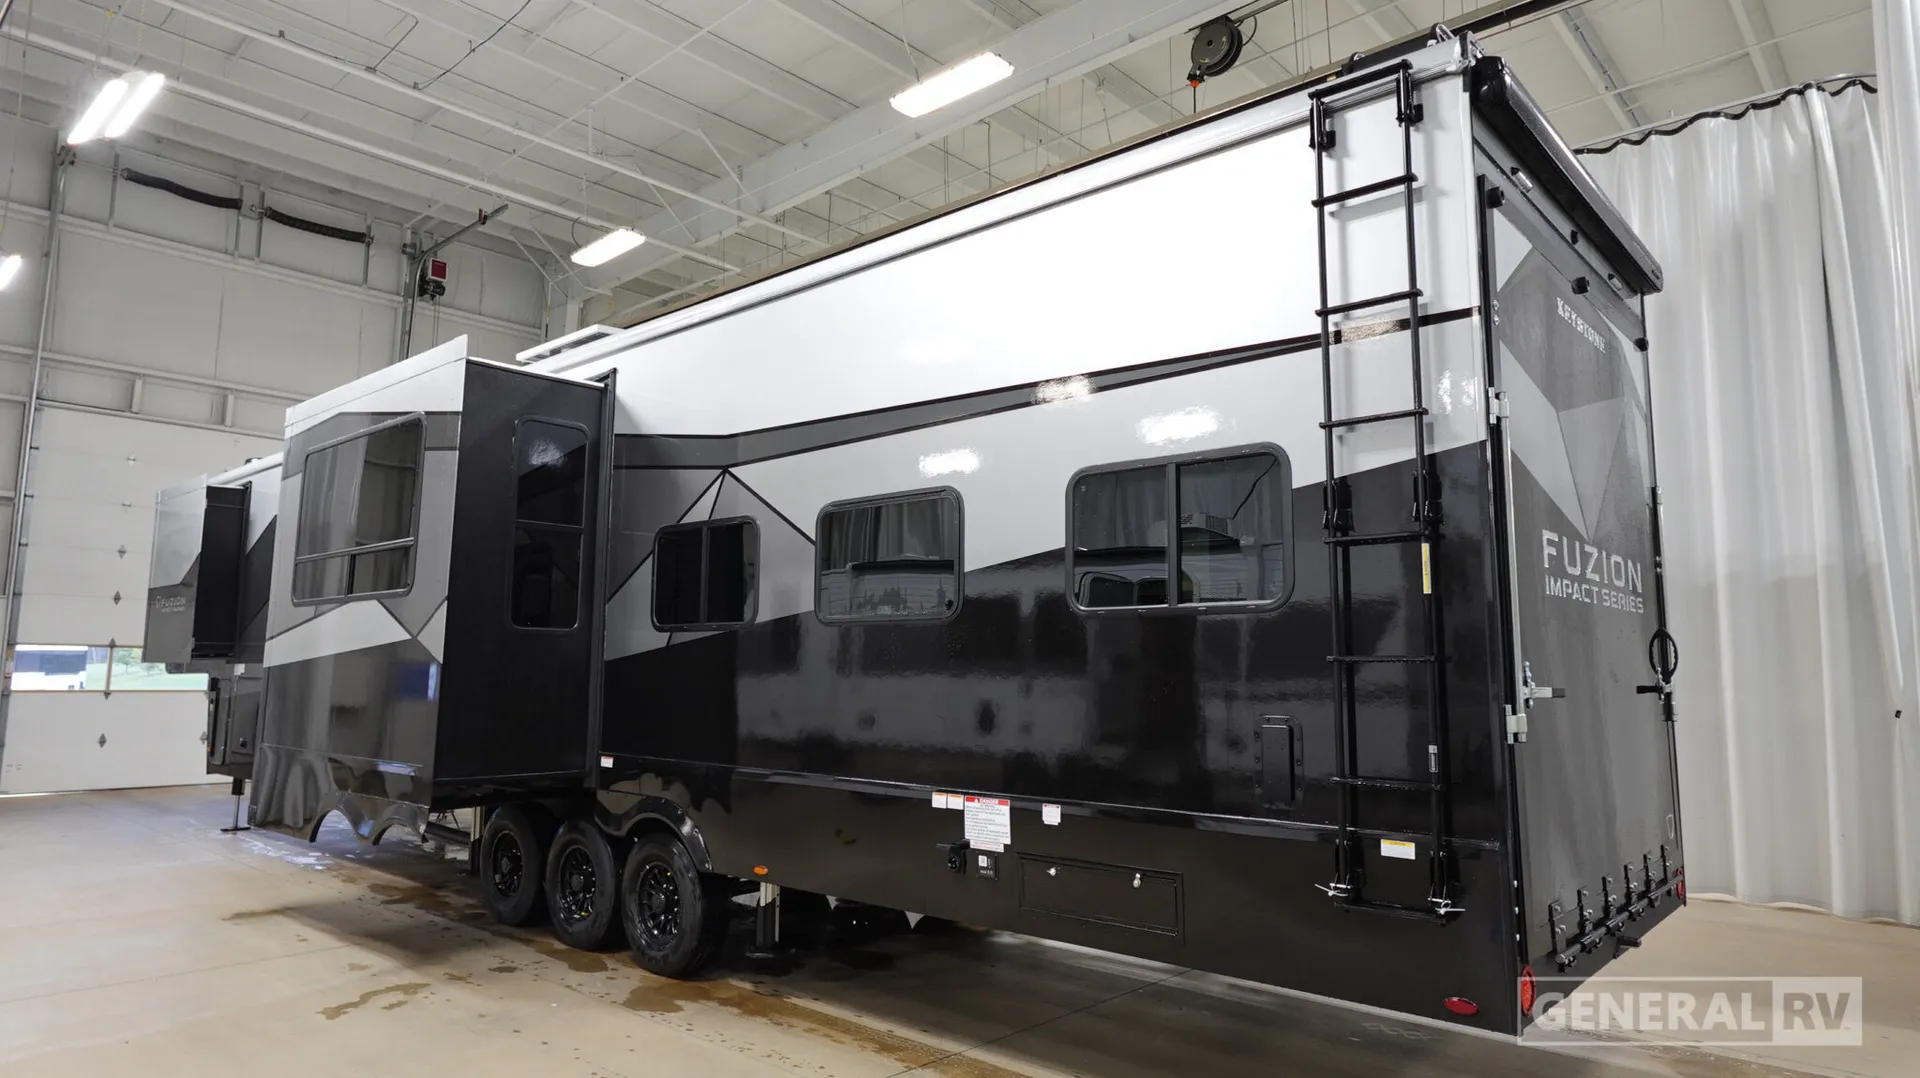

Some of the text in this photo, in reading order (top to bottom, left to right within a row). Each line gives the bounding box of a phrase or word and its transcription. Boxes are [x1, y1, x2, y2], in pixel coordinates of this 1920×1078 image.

[1556, 297, 1606, 354] KEYSTONE
[1541, 529, 1643, 593] FUZION
[1545, 574, 1644, 614] IMPACT SERIES
